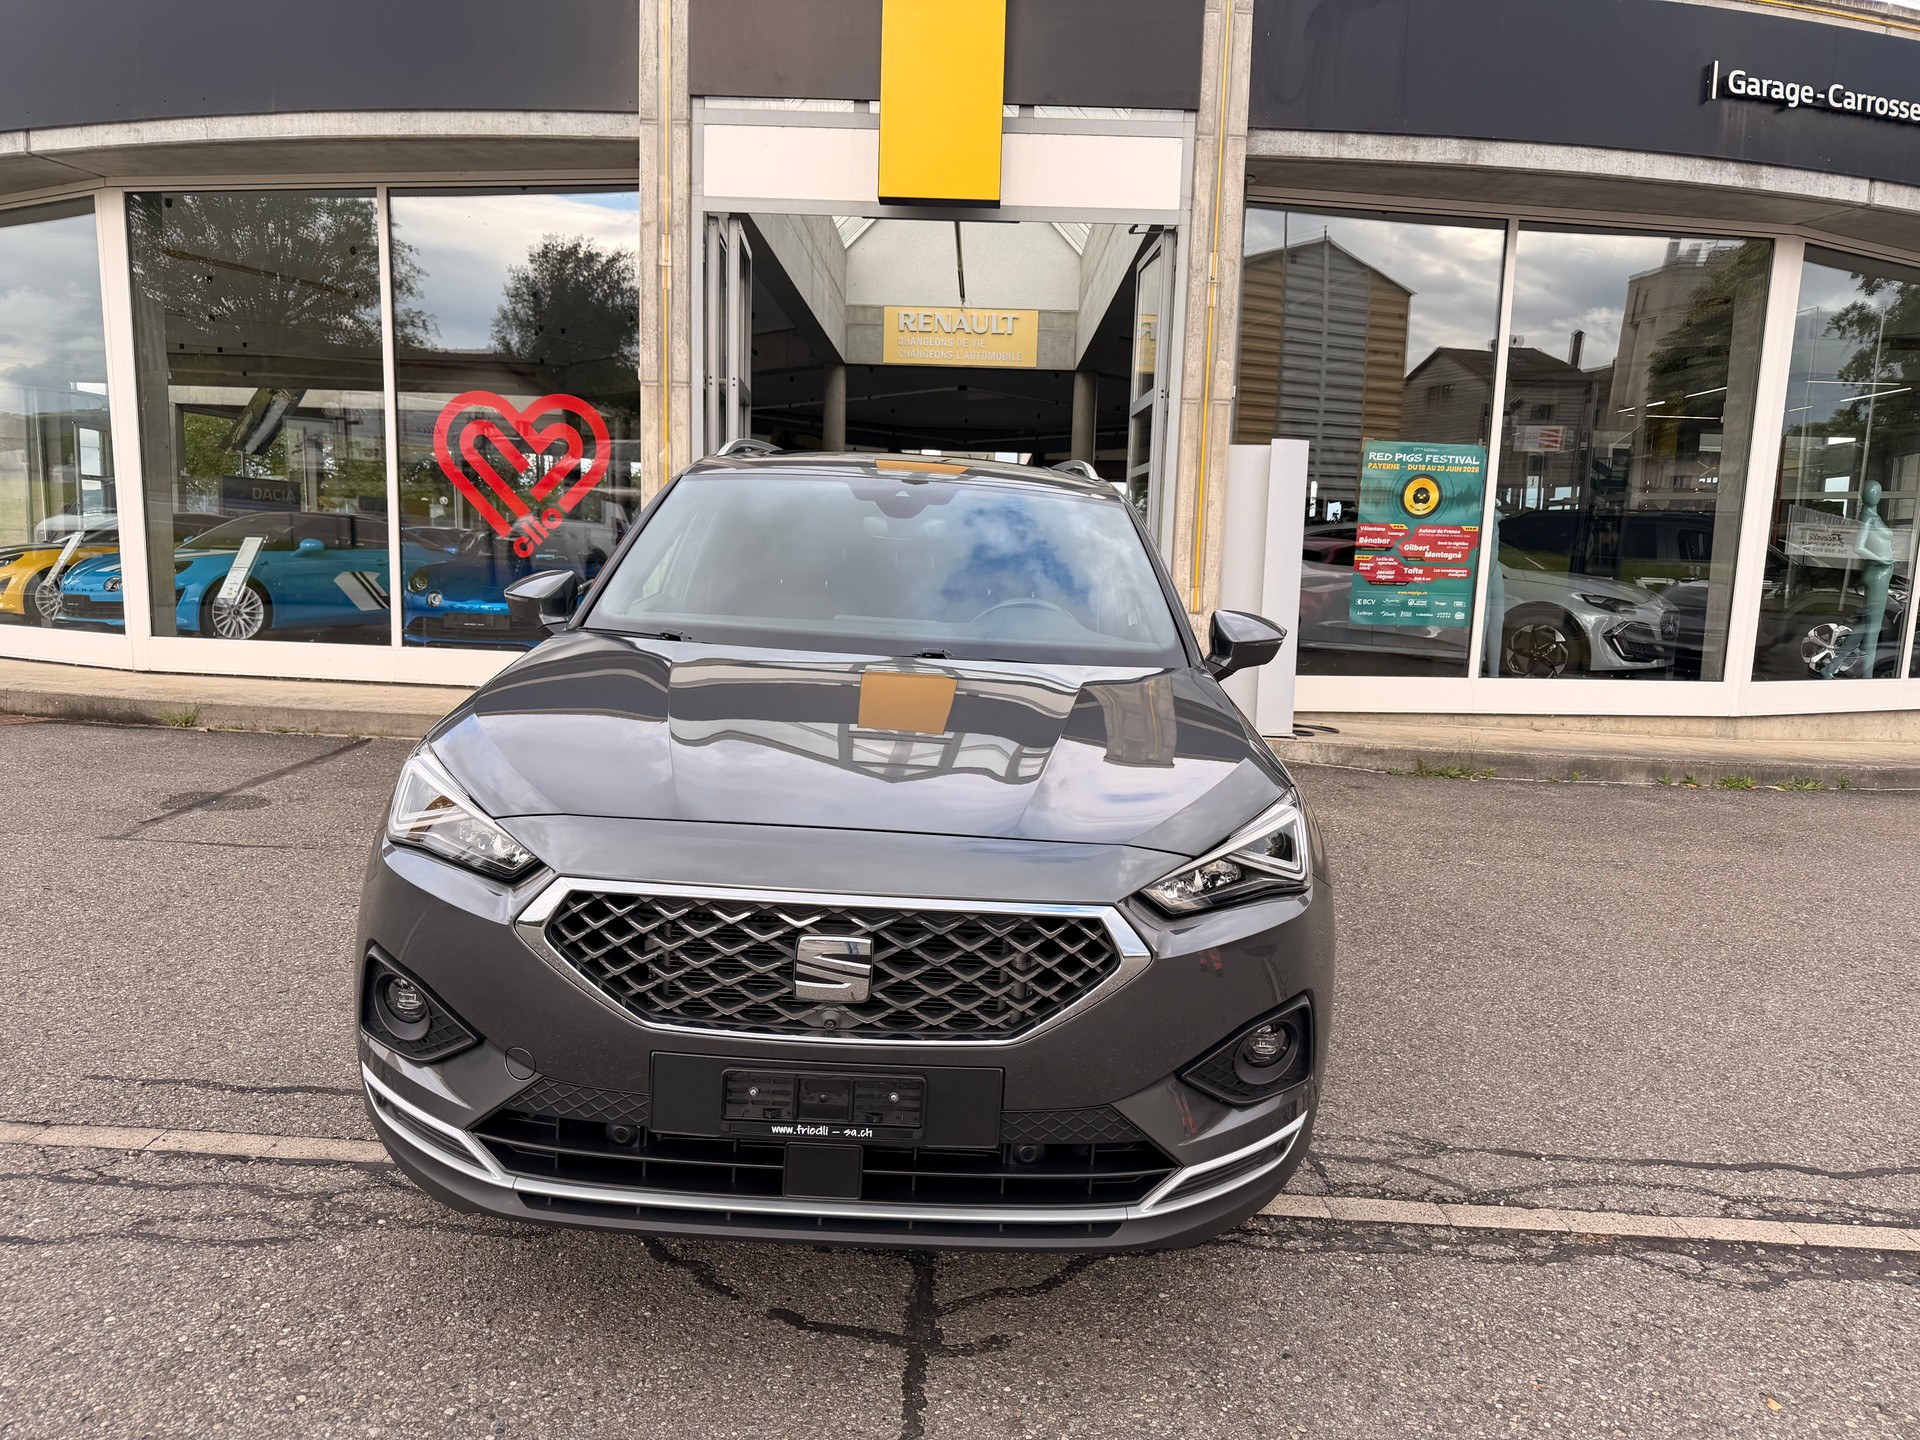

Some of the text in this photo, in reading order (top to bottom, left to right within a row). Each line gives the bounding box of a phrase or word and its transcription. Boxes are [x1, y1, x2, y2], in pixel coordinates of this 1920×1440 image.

[898, 312, 1019, 335] RENAULT
[898, 337, 987, 348] CHANGEONS DE VIE
[898, 349, 953, 360] CHANGEONS
[1369, 452, 1480, 465] RED PIGS FESTIVAL
[252, 487, 296, 502] DACIA
[513, 507, 563, 558] clio
[1359, 536, 1391, 544] Bénabar
[1425, 551, 1462, 560] Montagné
[1404, 567, 1424, 575] Tafta
[771, 1124, 829, 1136] www.friedli
[843, 1127, 873, 1138] sa.ch
